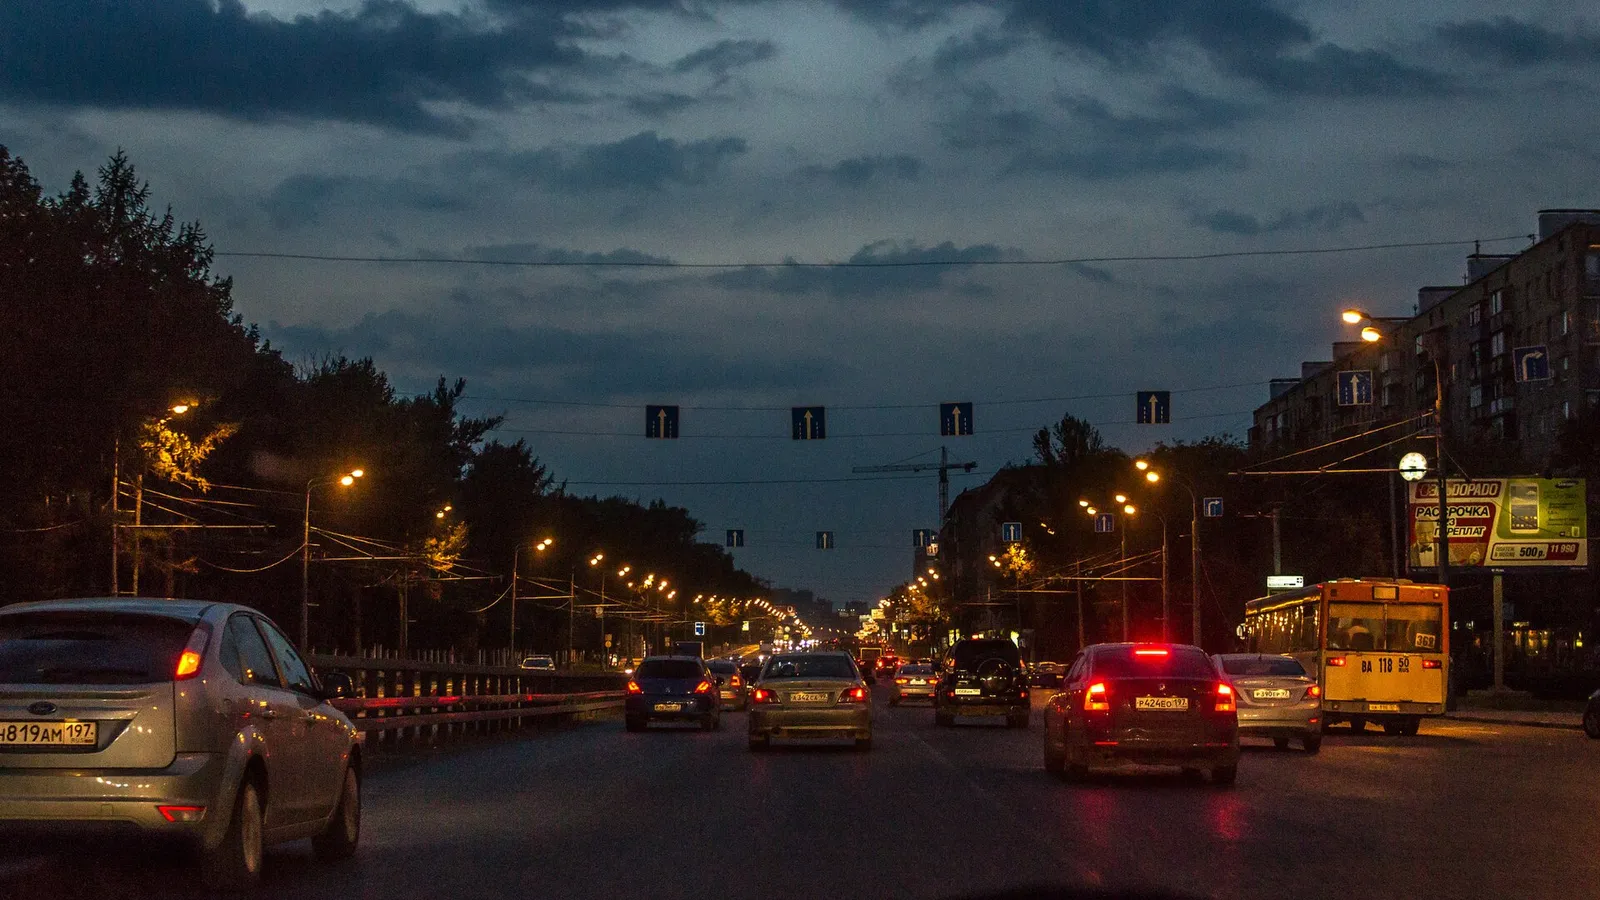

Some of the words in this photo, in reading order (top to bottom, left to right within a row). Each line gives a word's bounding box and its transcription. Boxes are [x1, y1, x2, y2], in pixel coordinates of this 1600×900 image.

[1434, 527, 1484, 536] ПРЕПЛАТ
[1519, 547, 1538, 557] 500
[1361, 660, 1372, 673] ВА
[1378, 658, 1392, 672] 118
[1398, 657, 1409, 667] 50
[1139, 699, 1172, 707] Р424ЕО
[66, 723, 91, 737] 197
